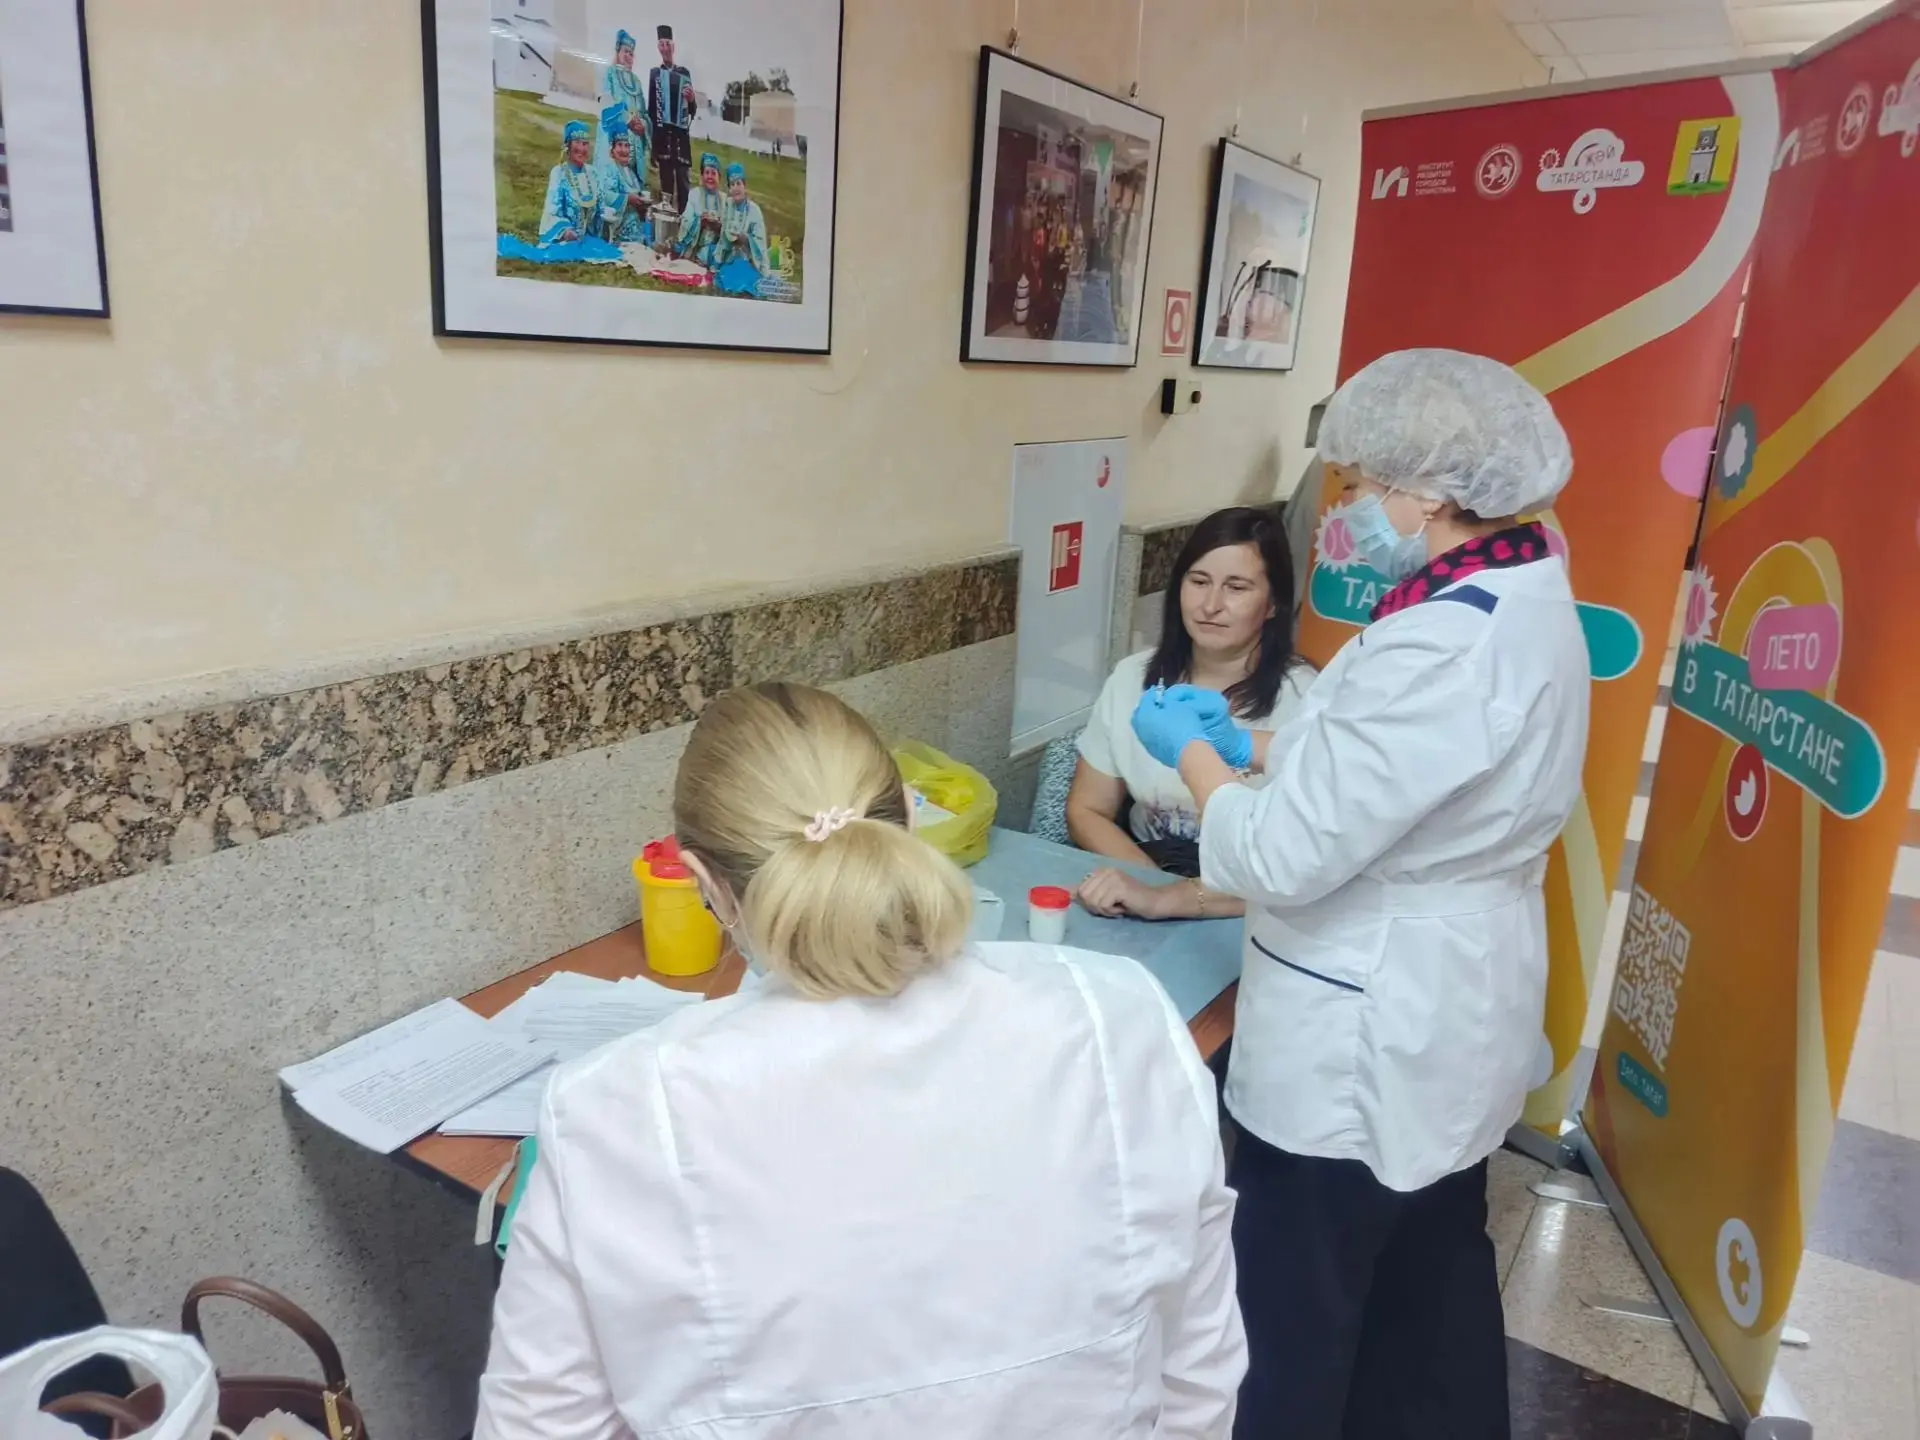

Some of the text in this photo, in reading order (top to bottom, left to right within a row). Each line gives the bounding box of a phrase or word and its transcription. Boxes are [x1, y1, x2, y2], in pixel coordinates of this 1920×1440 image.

[1550, 166, 1631, 185] ТАТАРСТАНДА
[1762, 631, 1821, 671] ЛЕТО
[1682, 658, 1845, 786] В ТАТАРСТАНЕ
